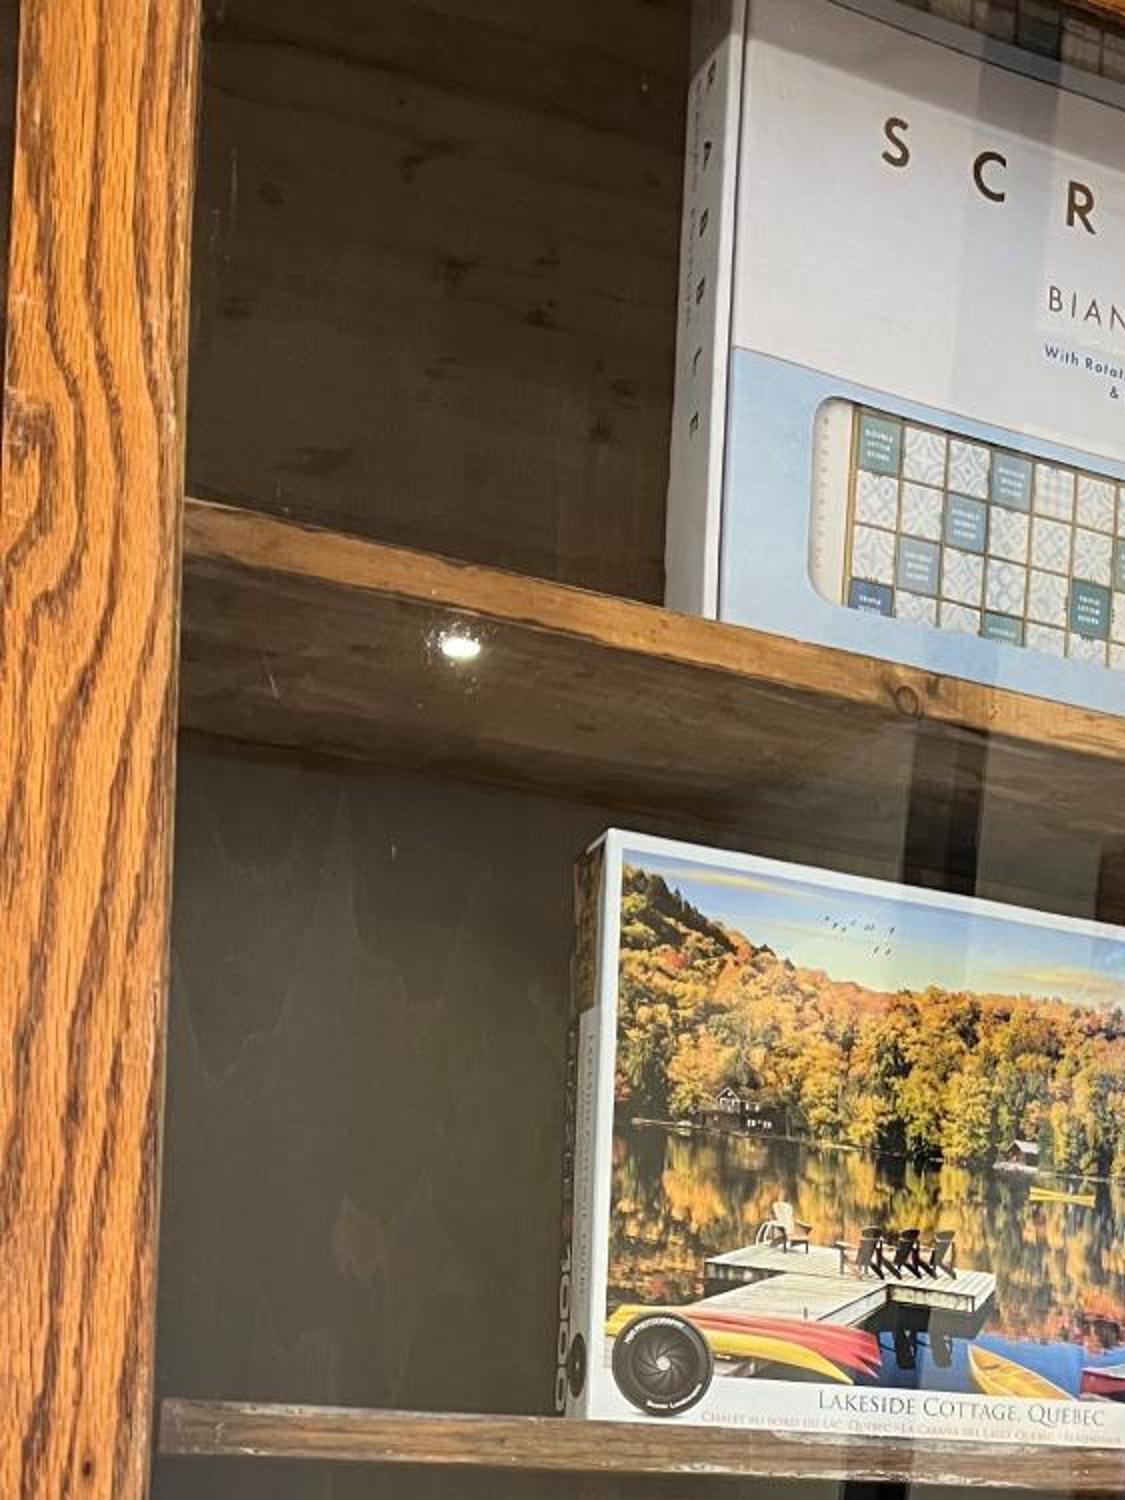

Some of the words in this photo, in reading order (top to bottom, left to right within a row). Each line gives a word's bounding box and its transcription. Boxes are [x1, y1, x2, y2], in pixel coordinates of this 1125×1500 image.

[1045, 344, 1080, 367] With
[1109, 385, 1119, 400] &
[818, 1391, 914, 1417] LAKESIDE
[923, 1396, 1021, 1422] COTTAGE,
